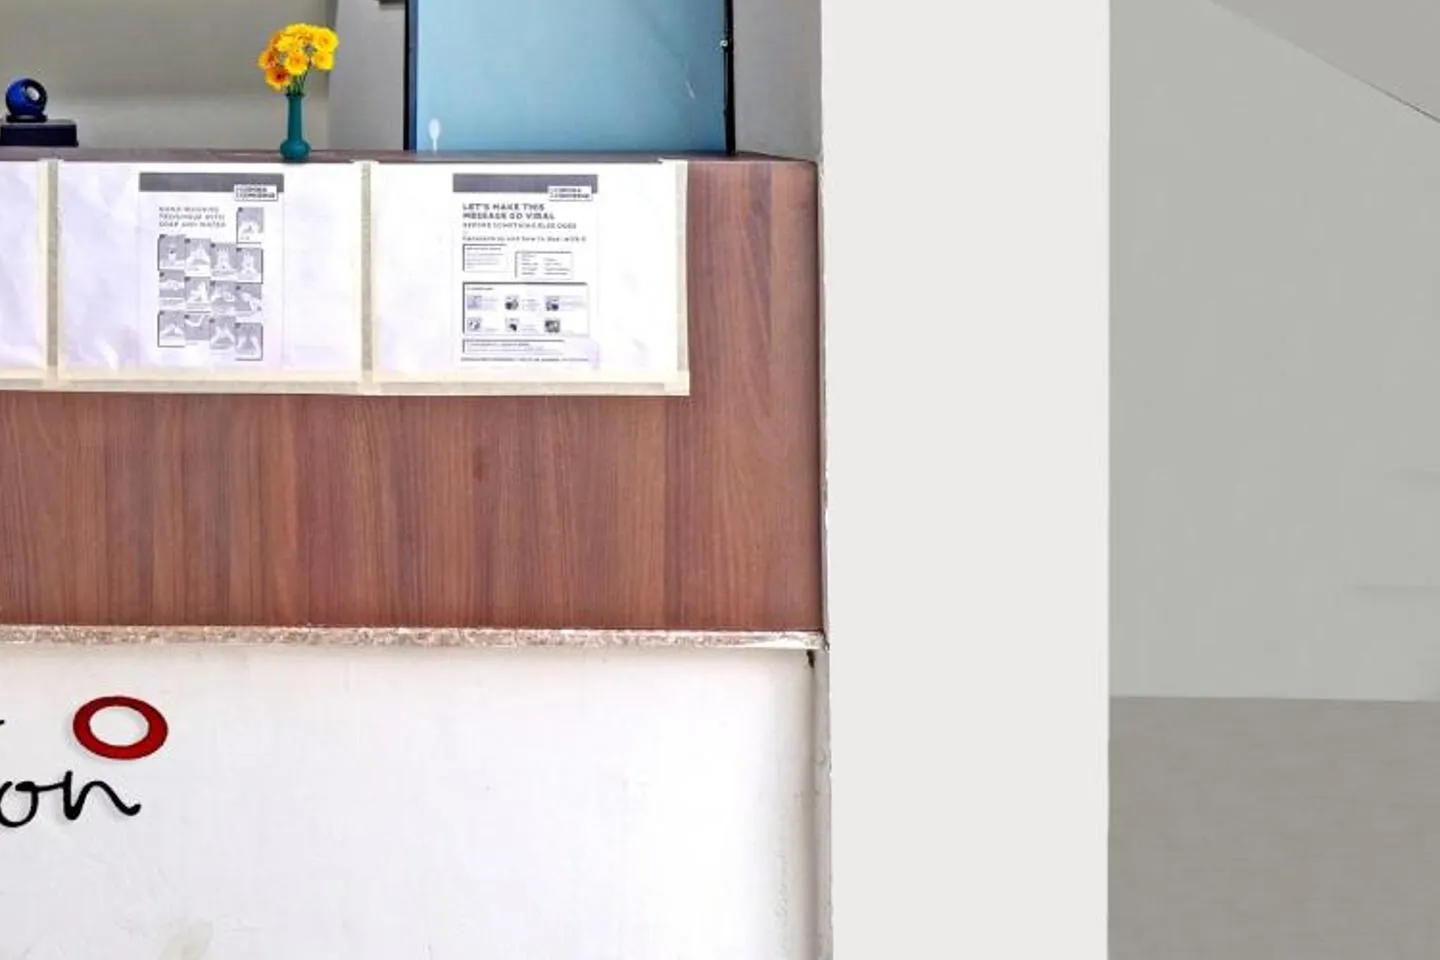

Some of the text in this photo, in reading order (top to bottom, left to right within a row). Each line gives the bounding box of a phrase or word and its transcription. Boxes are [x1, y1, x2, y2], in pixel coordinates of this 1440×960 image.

[462, 203, 545, 211] LET'S MAKE THIS
[462, 212, 556, 220] MESSAGE GO VIRAL
